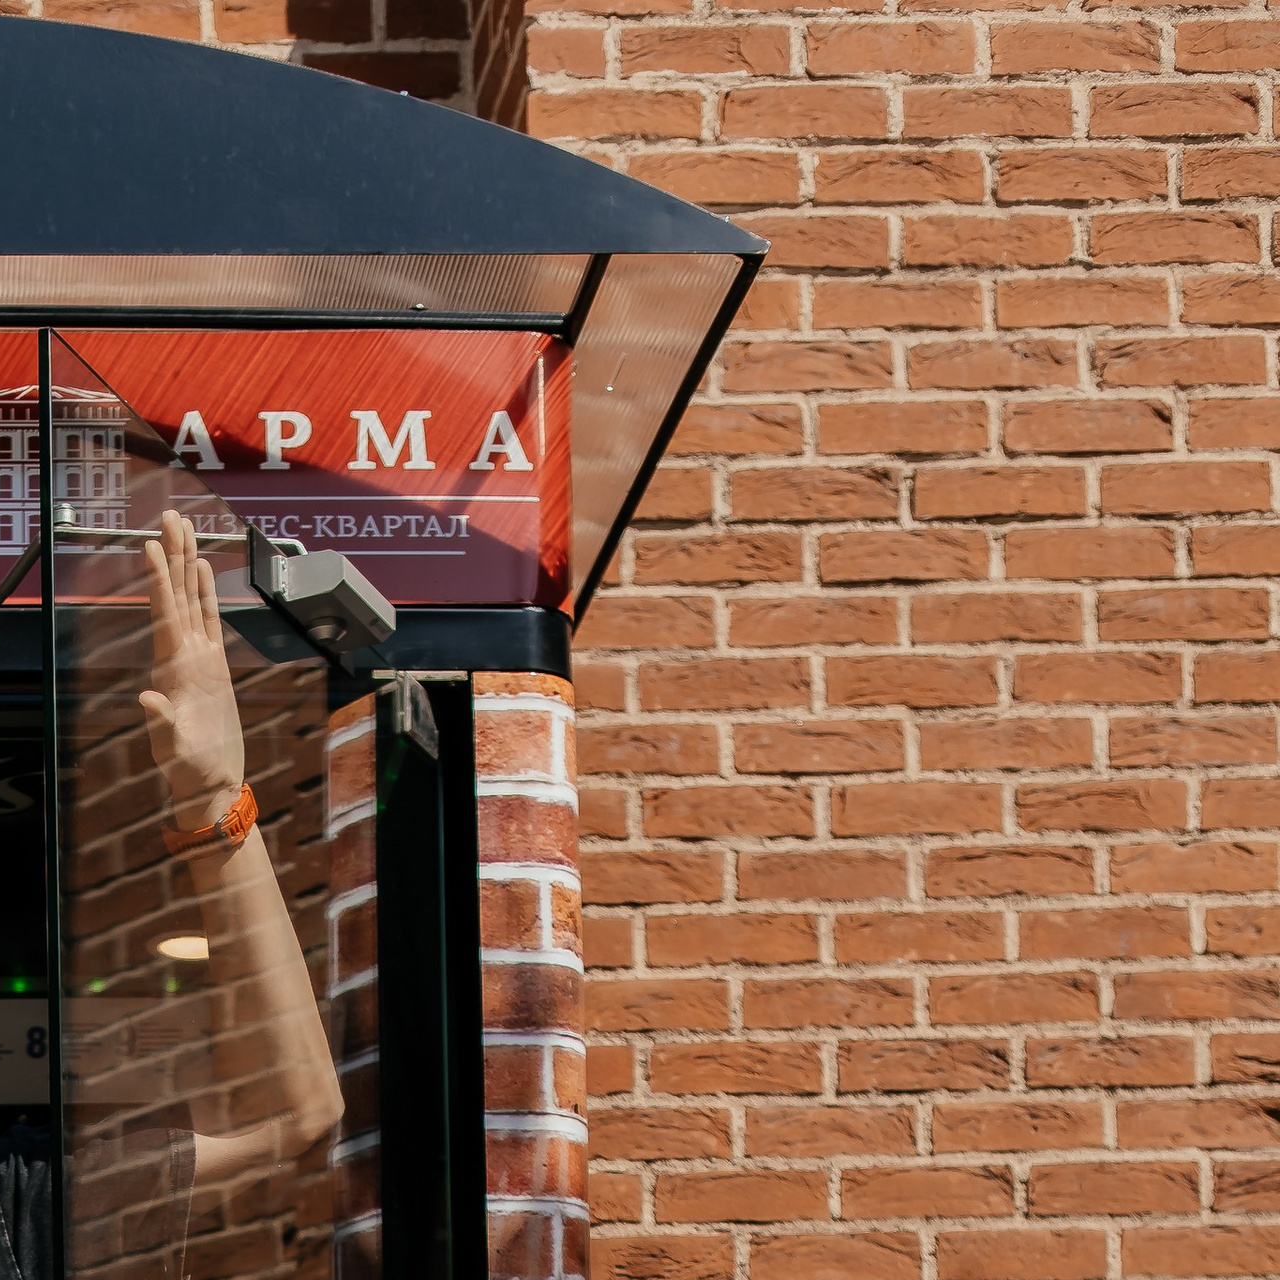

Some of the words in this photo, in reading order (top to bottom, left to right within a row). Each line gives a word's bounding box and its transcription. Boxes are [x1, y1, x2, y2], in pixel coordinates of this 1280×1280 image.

[169, 409, 534, 471] АРМА
[181, 513, 470, 540] ИЗЕС-КВАРТАЛ
[26, 1026, 47, 1059] 8
